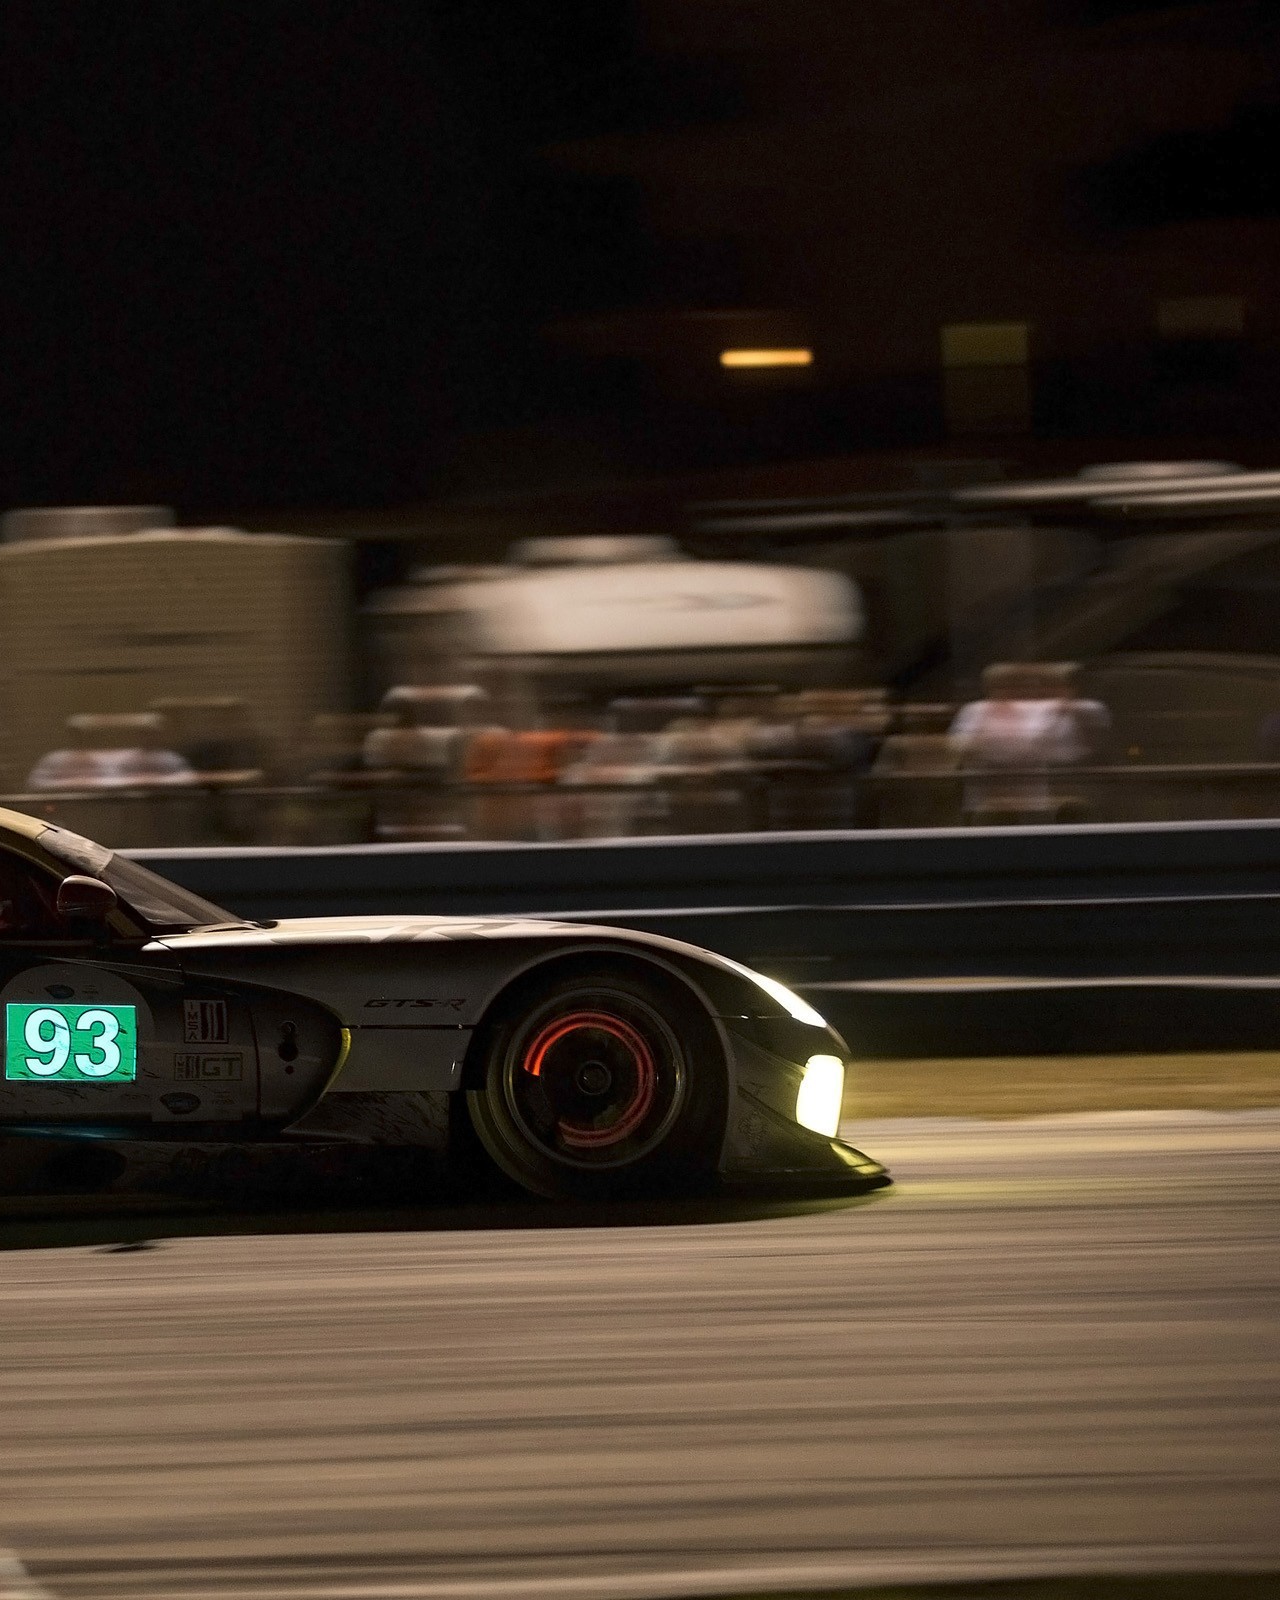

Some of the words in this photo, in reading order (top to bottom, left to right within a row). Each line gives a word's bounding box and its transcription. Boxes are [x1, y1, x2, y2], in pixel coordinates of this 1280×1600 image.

[363, 999, 466, 1011] GTS-R
[187, 1001, 199, 1040] IMSA
[24, 1008, 121, 1077] 93
[202, 1057, 241, 1076] GT
